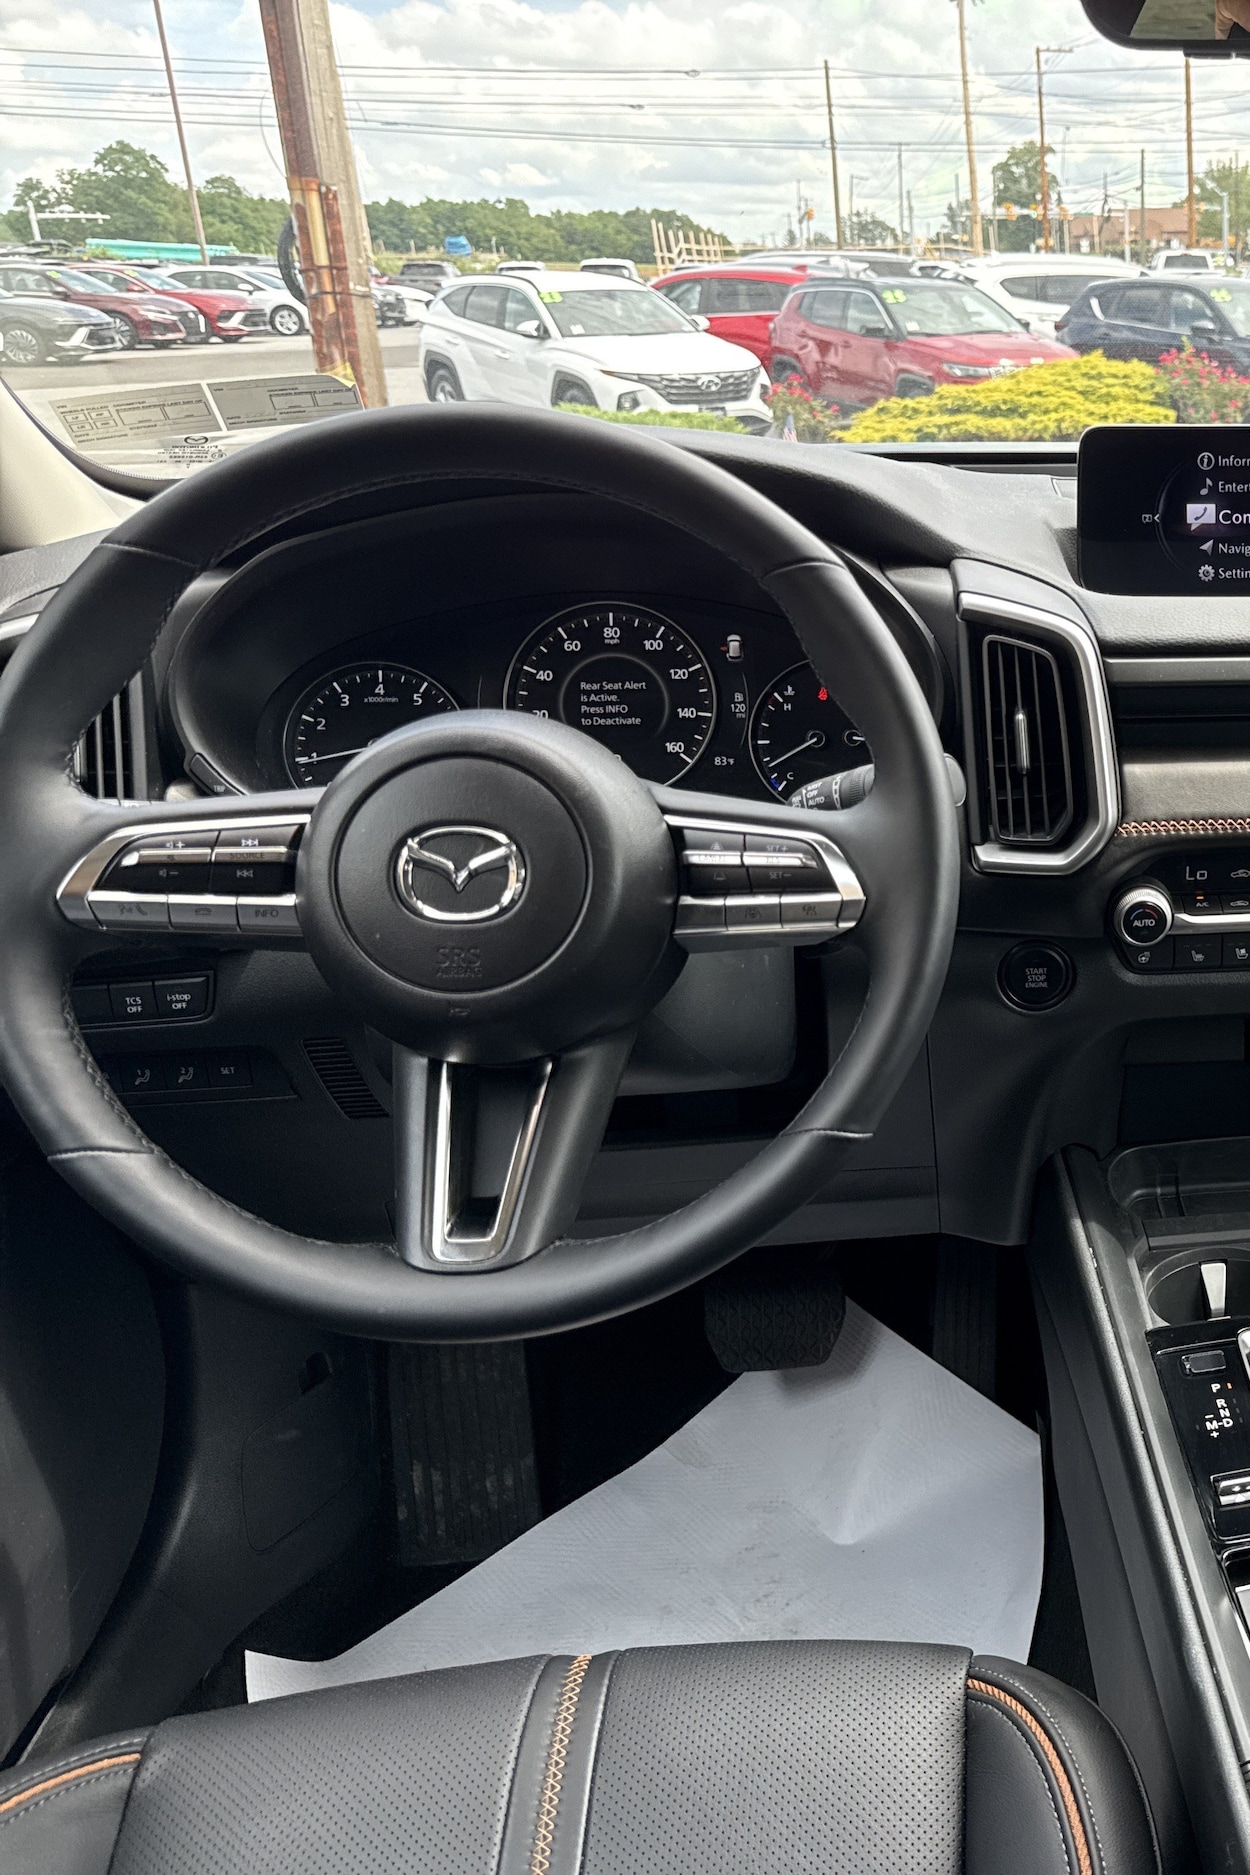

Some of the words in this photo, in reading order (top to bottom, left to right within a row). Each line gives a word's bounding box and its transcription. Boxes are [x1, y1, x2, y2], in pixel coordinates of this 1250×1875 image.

[603, 627, 620, 639] 80
[564, 641, 581, 652] 60
[643, 640, 663, 651] 100
[536, 670, 553, 682] 40
[669, 669, 688, 680] 120
[374, 684, 386, 695] 4
[580, 681, 601, 690] Rear
[602, 681, 622, 690] Seat
[624, 681, 647, 690] Alert
[340, 694, 350, 707] 3
[413, 693, 422, 706] 5
[580, 693, 588, 702] is
[589, 693, 620, 702] Active.
[581, 705, 604, 714] Press
[605, 704, 629, 713] INFO
[730, 703, 746, 713] 120
[783, 703, 792, 711] H
[677, 708, 697, 719] 140
[316, 718, 326, 730] 2
[581, 717, 592, 725] to
[593, 716, 642, 726] Deactivate
[665, 741, 684, 753] 160
[786, 772, 794, 780] C
[806, 790, 819, 799] OFF
[808, 796, 826, 806] AUTO
[254, 908, 279, 919] INFO
[1132, 918, 1156, 928] AUTO
[435, 947, 482, 967] SRS
[1025, 967, 1048, 976] START
[1027, 974, 1047, 983] STOP
[1025, 981, 1048, 989] ENGINE
[125, 996, 142, 1005] TCS
[171, 1001, 188, 1010] OFF
[126, 1005, 143, 1014] OFF
[1210, 1383, 1221, 1393] P
[1216, 1398, 1228, 1408] R
[1219, 1408, 1231, 1417] N
